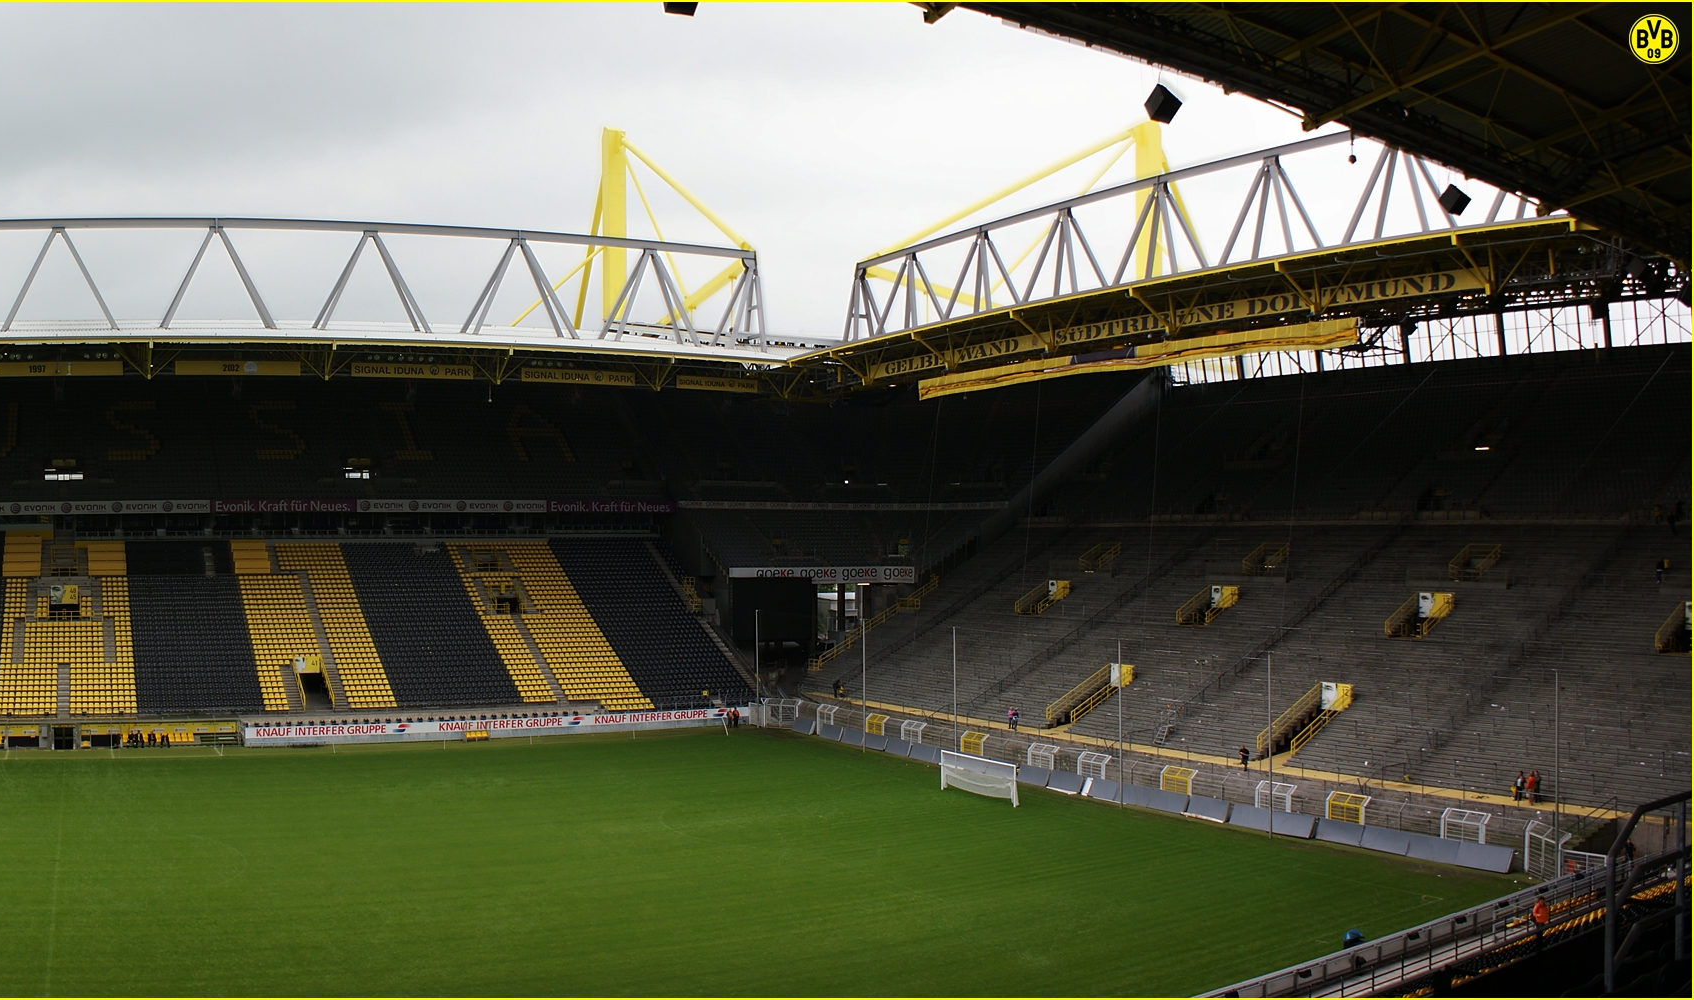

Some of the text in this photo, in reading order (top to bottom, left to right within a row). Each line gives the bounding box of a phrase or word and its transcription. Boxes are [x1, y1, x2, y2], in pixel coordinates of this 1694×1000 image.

[956, 339, 1019, 362] WAND
[29, 365, 46, 373] 1997
[354, 365, 471, 377] SIGNAL IDUNA PARK
[524, 370, 633, 383] SIGNAL IDUNA PARK
[679, 378, 703, 387] SIGNAL
[704, 380, 726, 388] IDUNA
[215, 500, 351, 512] Evonik. Kraft für Neues.
[551, 500, 589, 512] Evonik.
[592, 501, 618, 512] Kraft
[620, 501, 636, 512] für
[637, 502, 670, 512] Neues
[594, 710, 708, 724] KNAUF INTERFER GRUPPE
[438, 717, 563, 731] KNAUF INTERFER GRUPPE
[255, 724, 387, 737] KNAUF INTERFER GRUPPE
